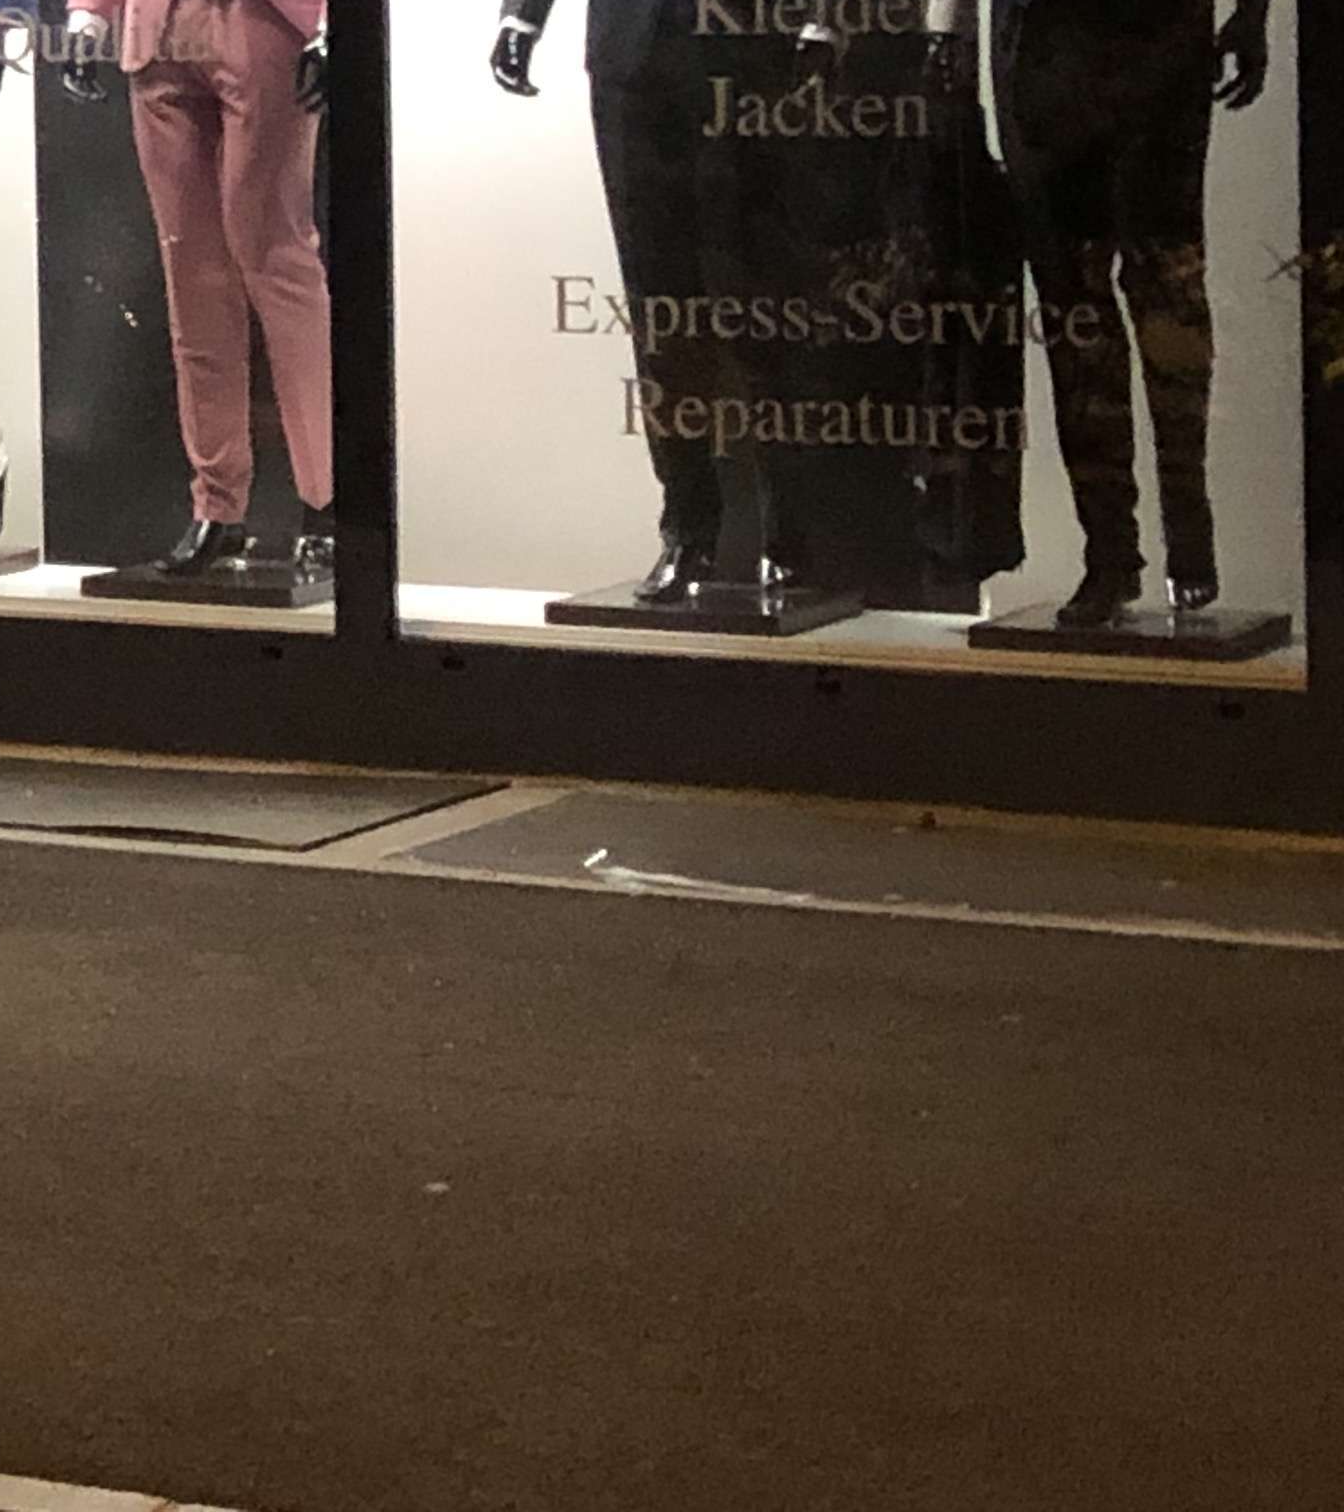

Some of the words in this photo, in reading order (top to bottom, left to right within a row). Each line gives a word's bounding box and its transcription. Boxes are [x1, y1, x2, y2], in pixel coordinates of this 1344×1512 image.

[702, 74, 932, 138] Jacken
[551, 274, 1102, 356] Express-Service
[619, 376, 1030, 458] Reparaturen
